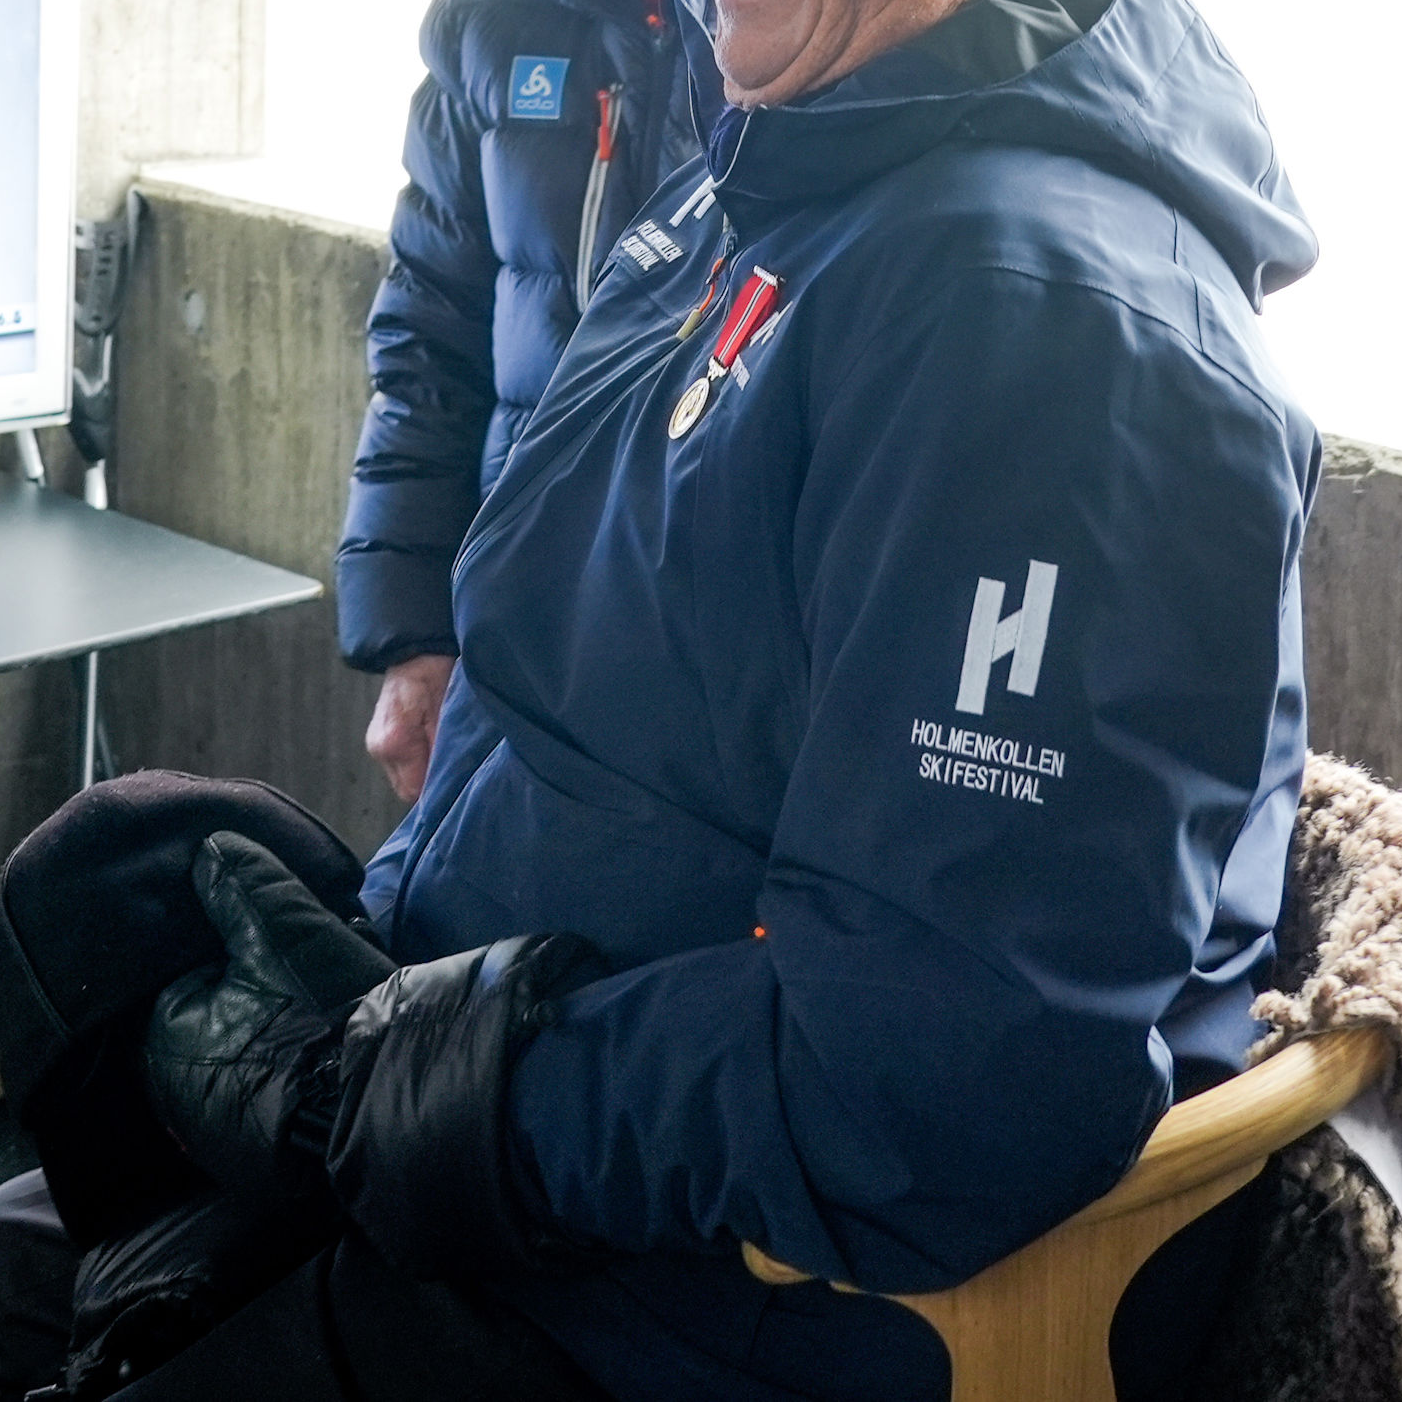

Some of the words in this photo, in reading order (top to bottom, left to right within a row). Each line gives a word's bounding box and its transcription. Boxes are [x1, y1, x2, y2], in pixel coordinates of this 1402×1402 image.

[955, 559, 1059, 716] H
[910, 718, 1066, 778] HOLMENKOLLEN
[918, 752, 1044, 805] SKIFESTIVAL
